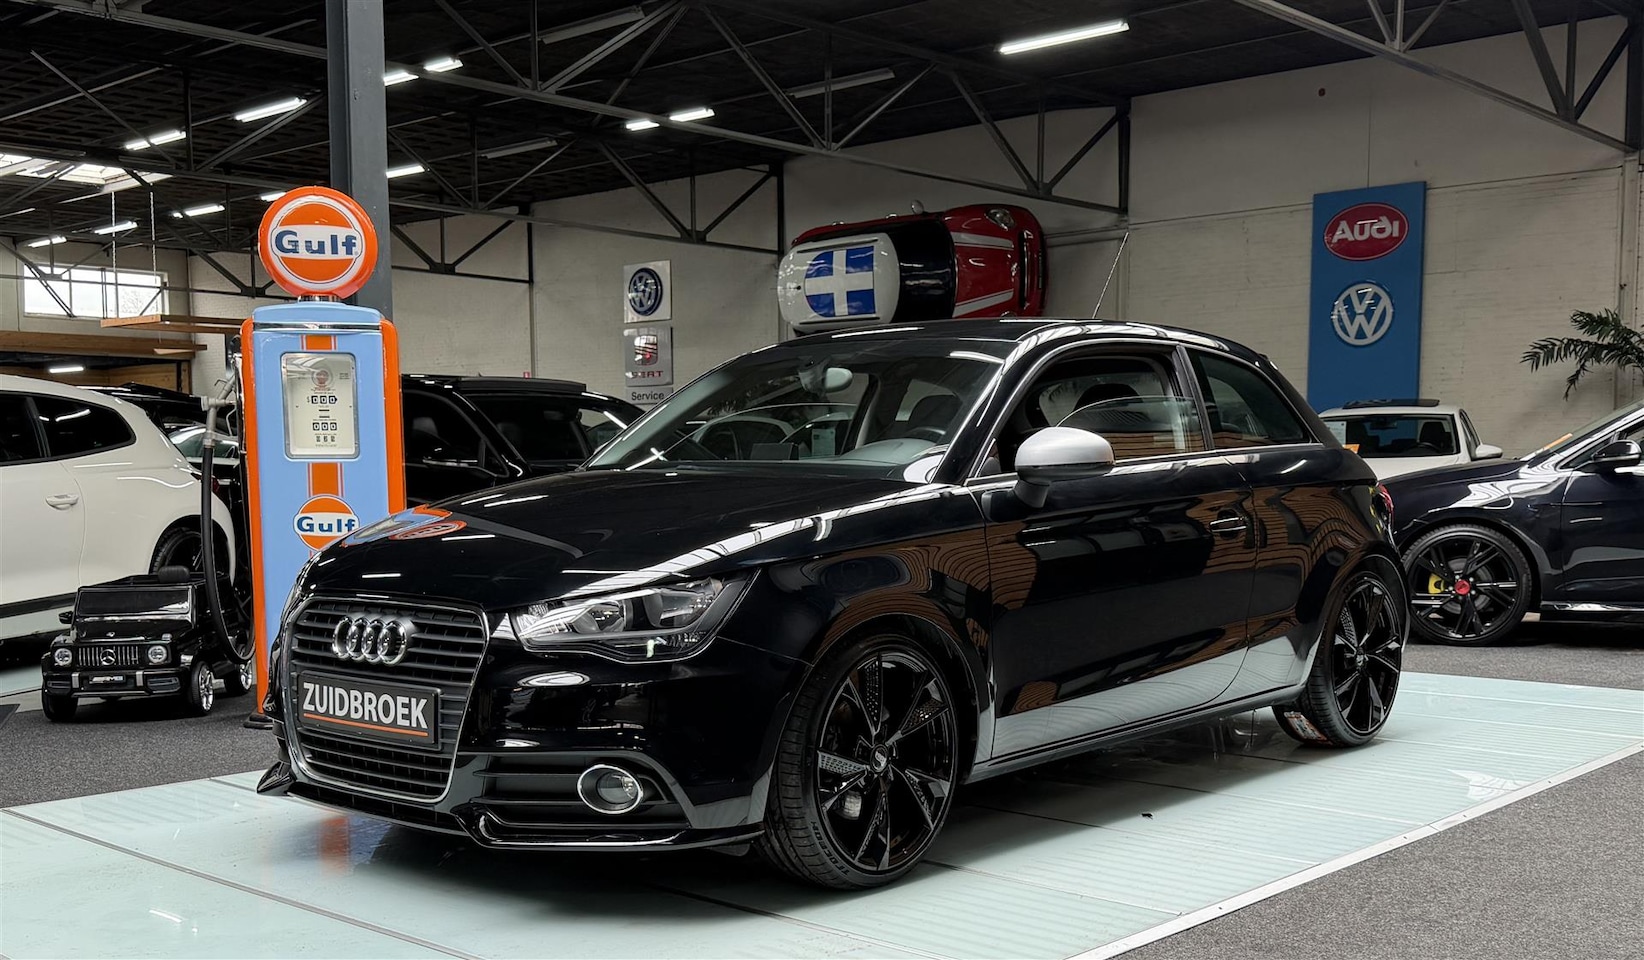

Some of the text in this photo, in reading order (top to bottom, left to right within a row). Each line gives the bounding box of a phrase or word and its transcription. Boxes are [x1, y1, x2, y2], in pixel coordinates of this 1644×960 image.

[274, 230, 357, 256] Gulf
[1335, 285, 1390, 344] VW
[631, 390, 665, 401] Service
[296, 516, 356, 533] Gulf
[303, 682, 428, 729] ZUIDBROEK
